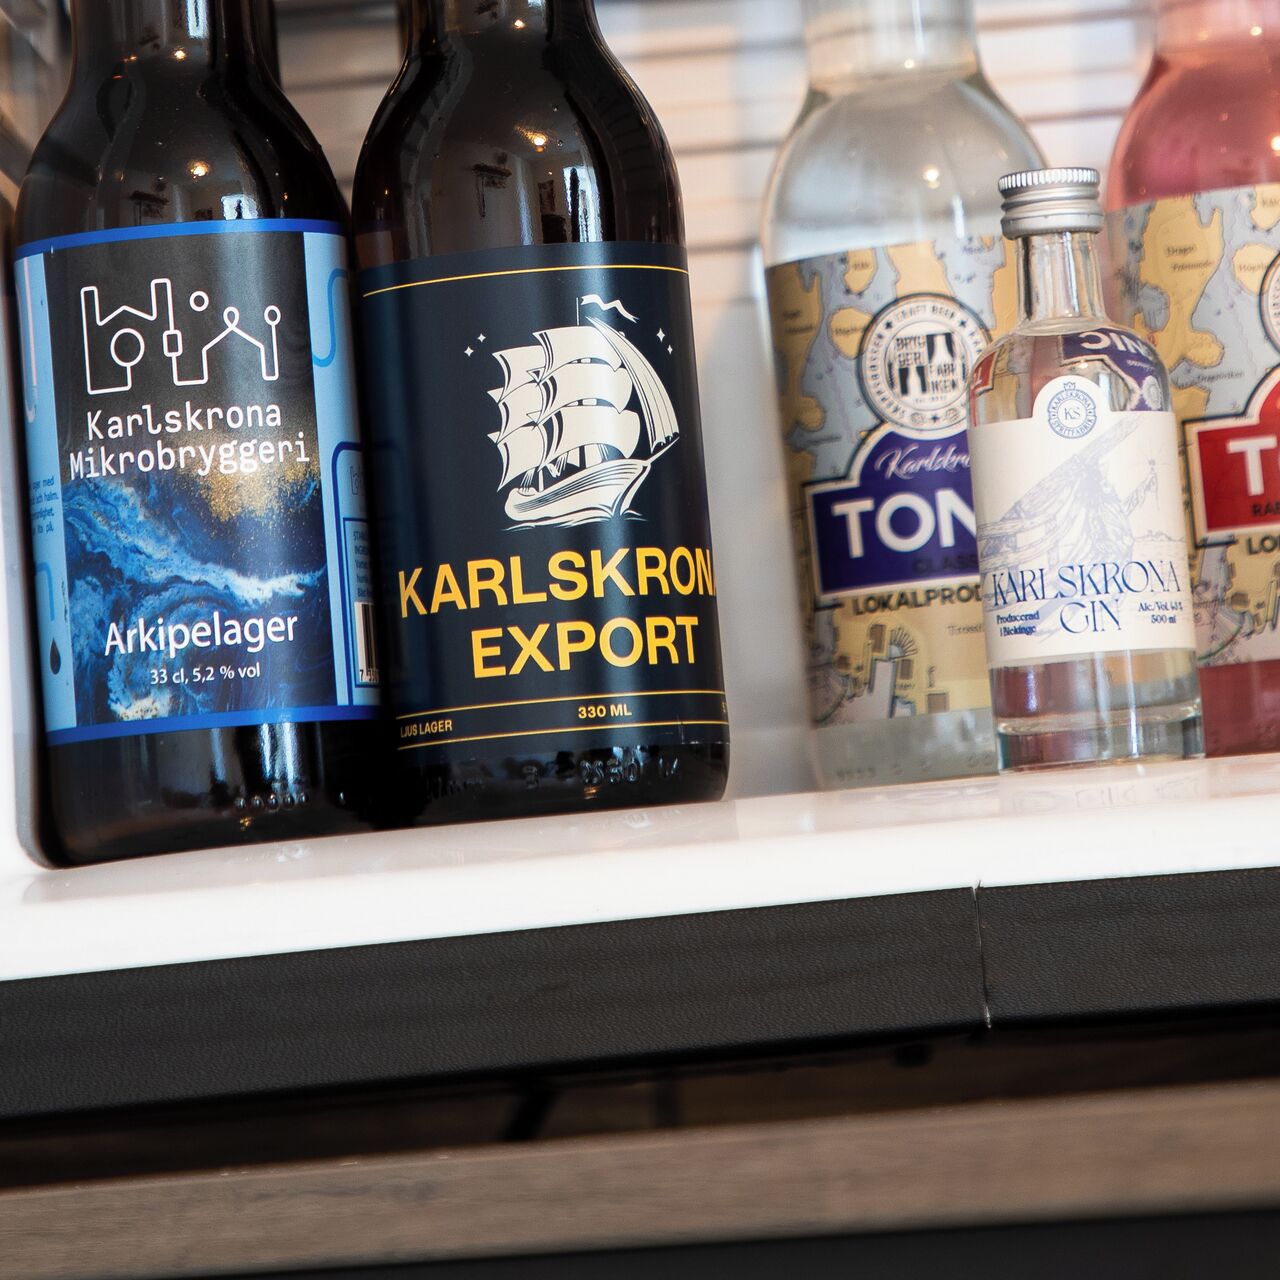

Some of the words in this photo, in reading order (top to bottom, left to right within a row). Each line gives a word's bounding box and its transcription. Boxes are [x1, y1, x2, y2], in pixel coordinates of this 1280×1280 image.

[87, 401, 281, 441] Karlskrona
[1064, 407, 1082, 420] KS
[70, 432, 310, 481] Mikrobryggeri
[831, 488, 977, 558] TON
[398, 546, 717, 618] KARLSKRON
[992, 560, 1182, 606] KARLSKRONA
[105, 611, 299, 659] Arkipelager
[1060, 598, 1122, 634] GIN
[471, 616, 699, 679] EXPORT
[150, 669, 168, 685] 33
[172, 667, 189, 685] cl,
[192, 666, 215, 684] 5,2
[220, 665, 235, 680] %
[238, 662, 261, 679] vol
[399, 723, 418, 739] LJUS
[419, 719, 454, 736] LAGER
[577, 705, 607, 720] 330
[610, 703, 632, 718] ML
